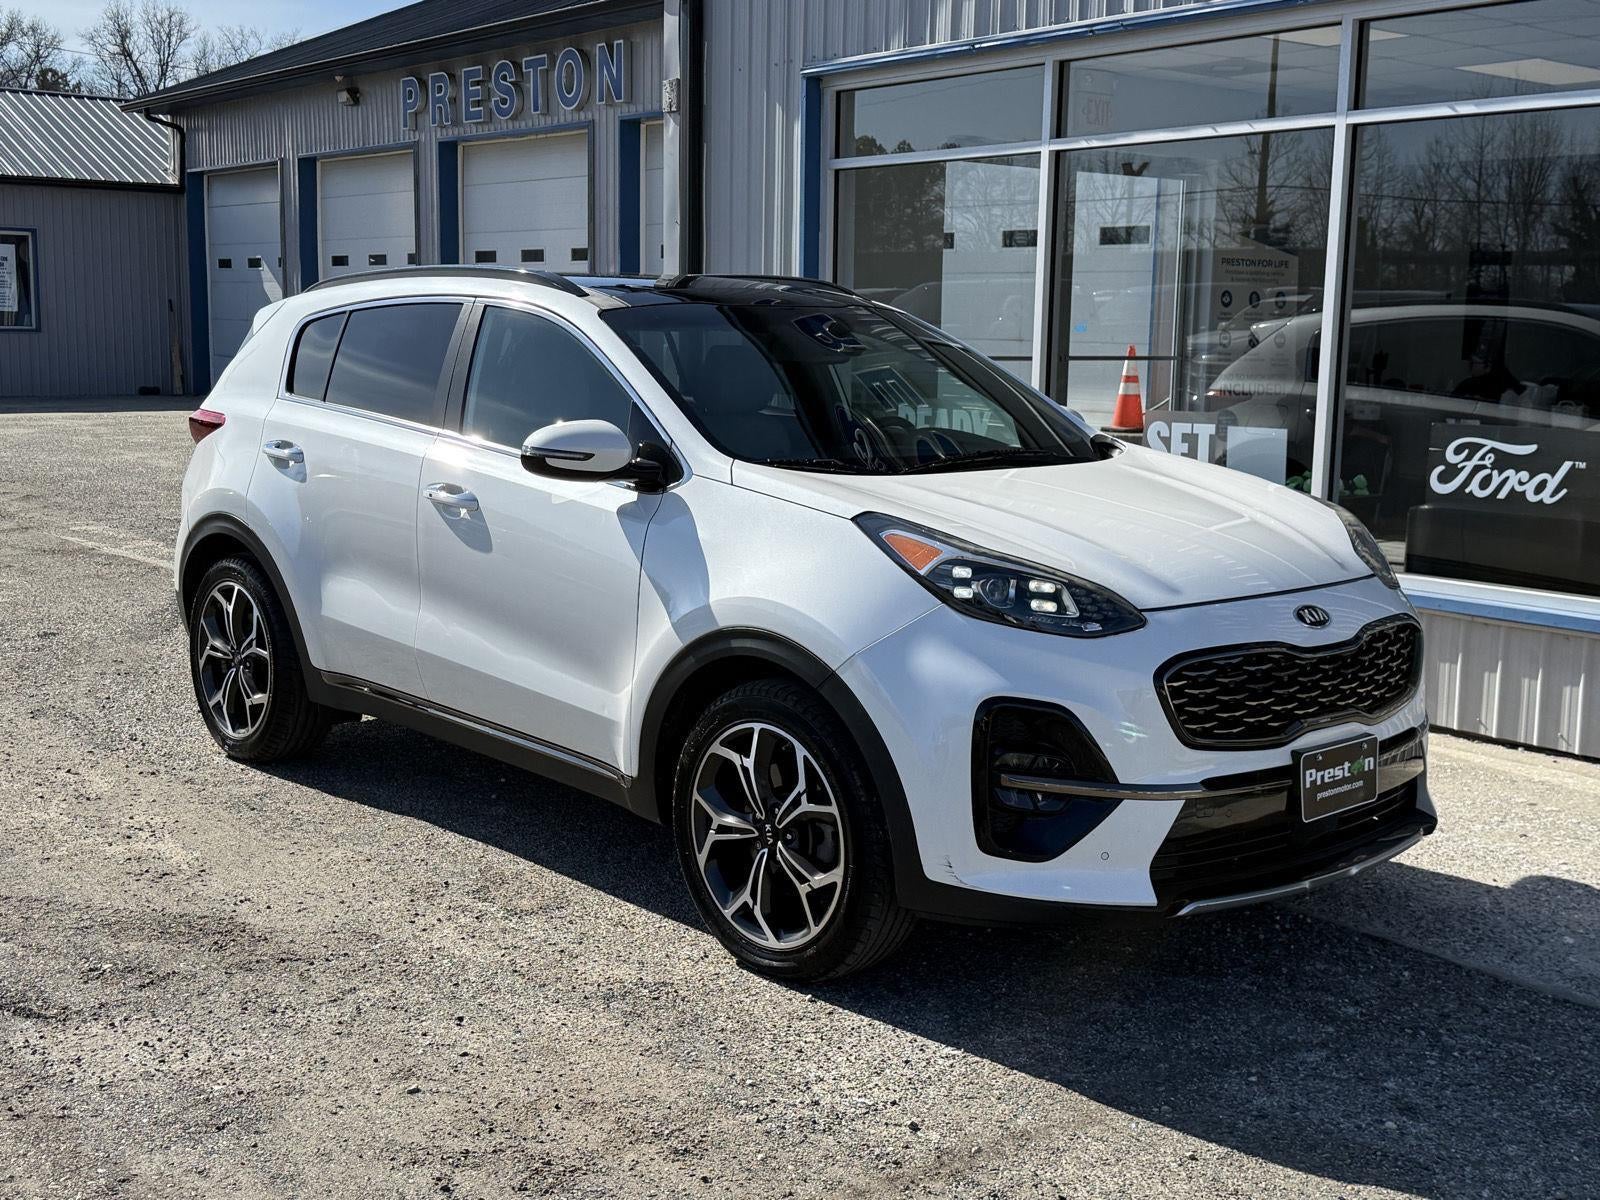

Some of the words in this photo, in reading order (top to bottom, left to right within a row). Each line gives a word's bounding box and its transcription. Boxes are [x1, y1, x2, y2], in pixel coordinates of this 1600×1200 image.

[400, 40, 627, 130] PRESTON
[1220, 256, 1257, 267] PRESTON
[1257, 258, 1273, 268] FOR
[1274, 259, 1289, 269] LIFE
[1429, 436, 1573, 505] Ford
[1316, 779, 1364, 802] prestonmotor.com
